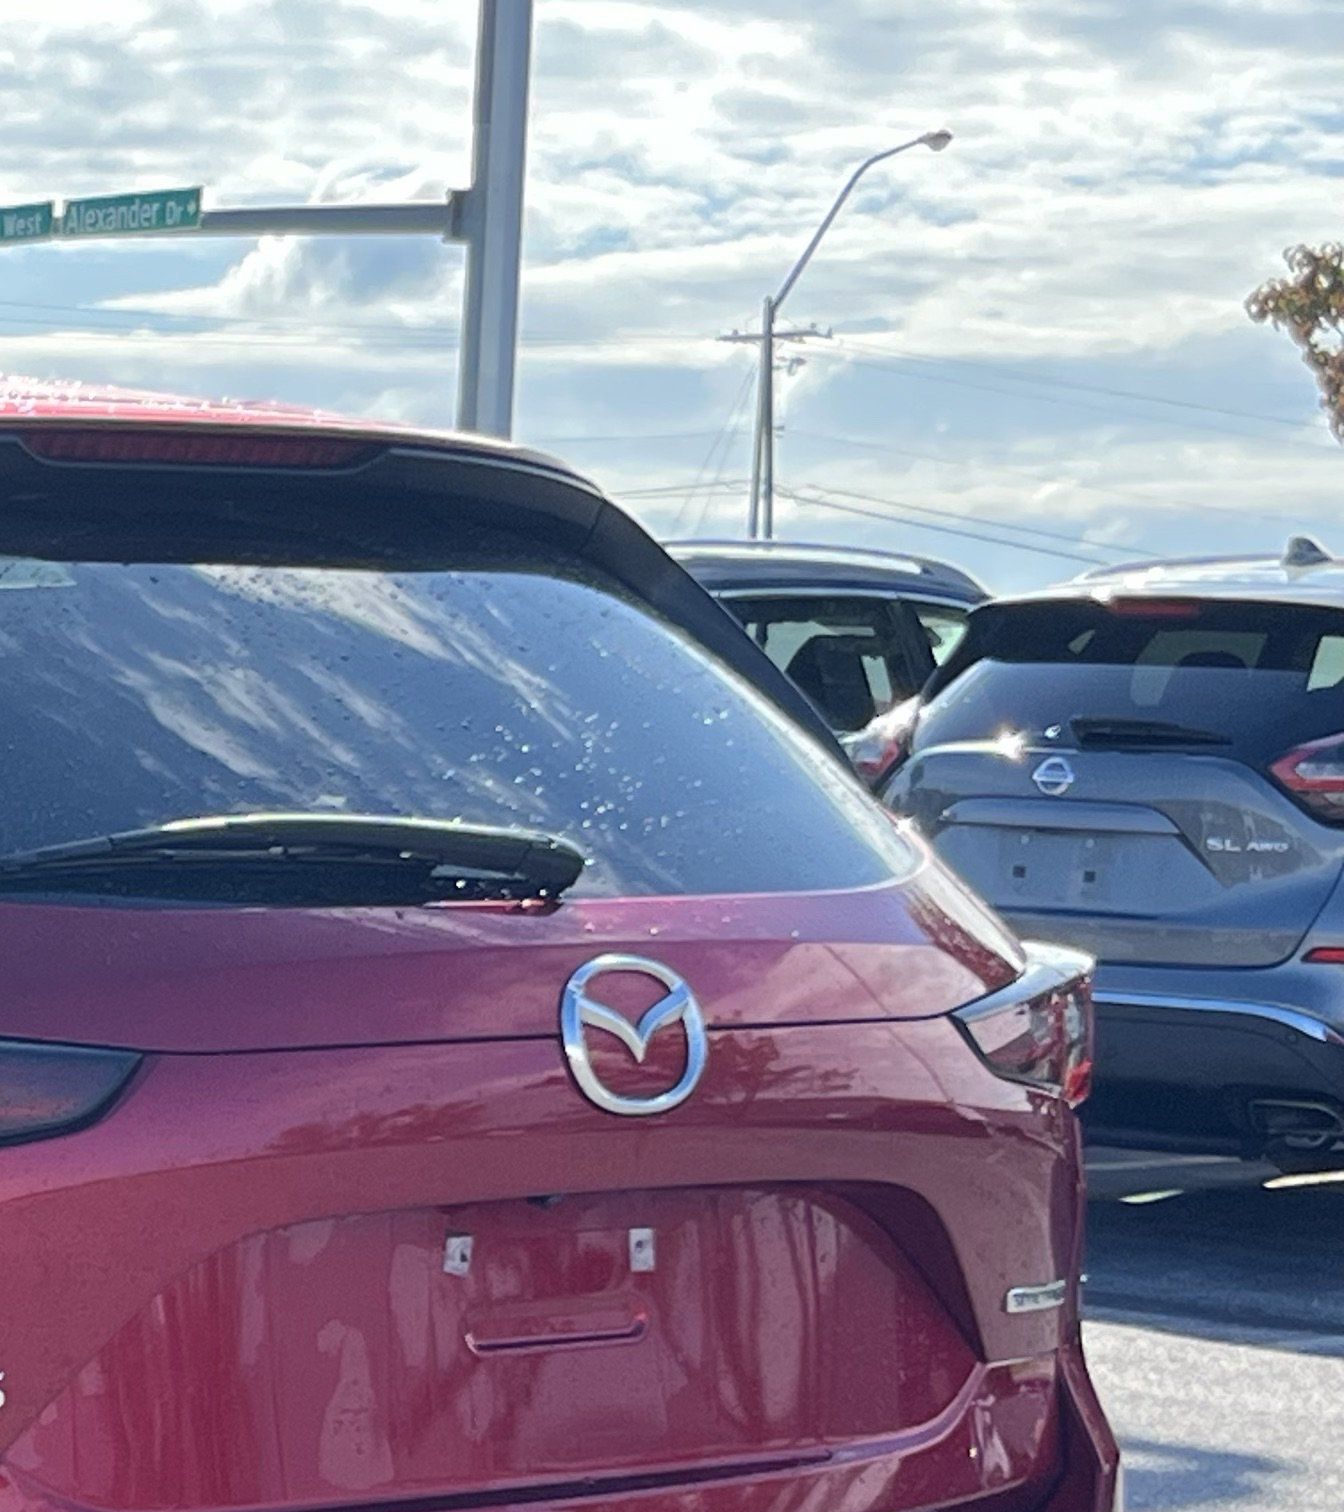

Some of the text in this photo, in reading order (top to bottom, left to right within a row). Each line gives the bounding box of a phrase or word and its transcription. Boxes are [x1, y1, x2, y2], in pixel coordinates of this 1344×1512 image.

[3, 213, 42, 237] West
[64, 199, 184, 234] Alexander Dr
[1206, 837, 1242, 852] SL
